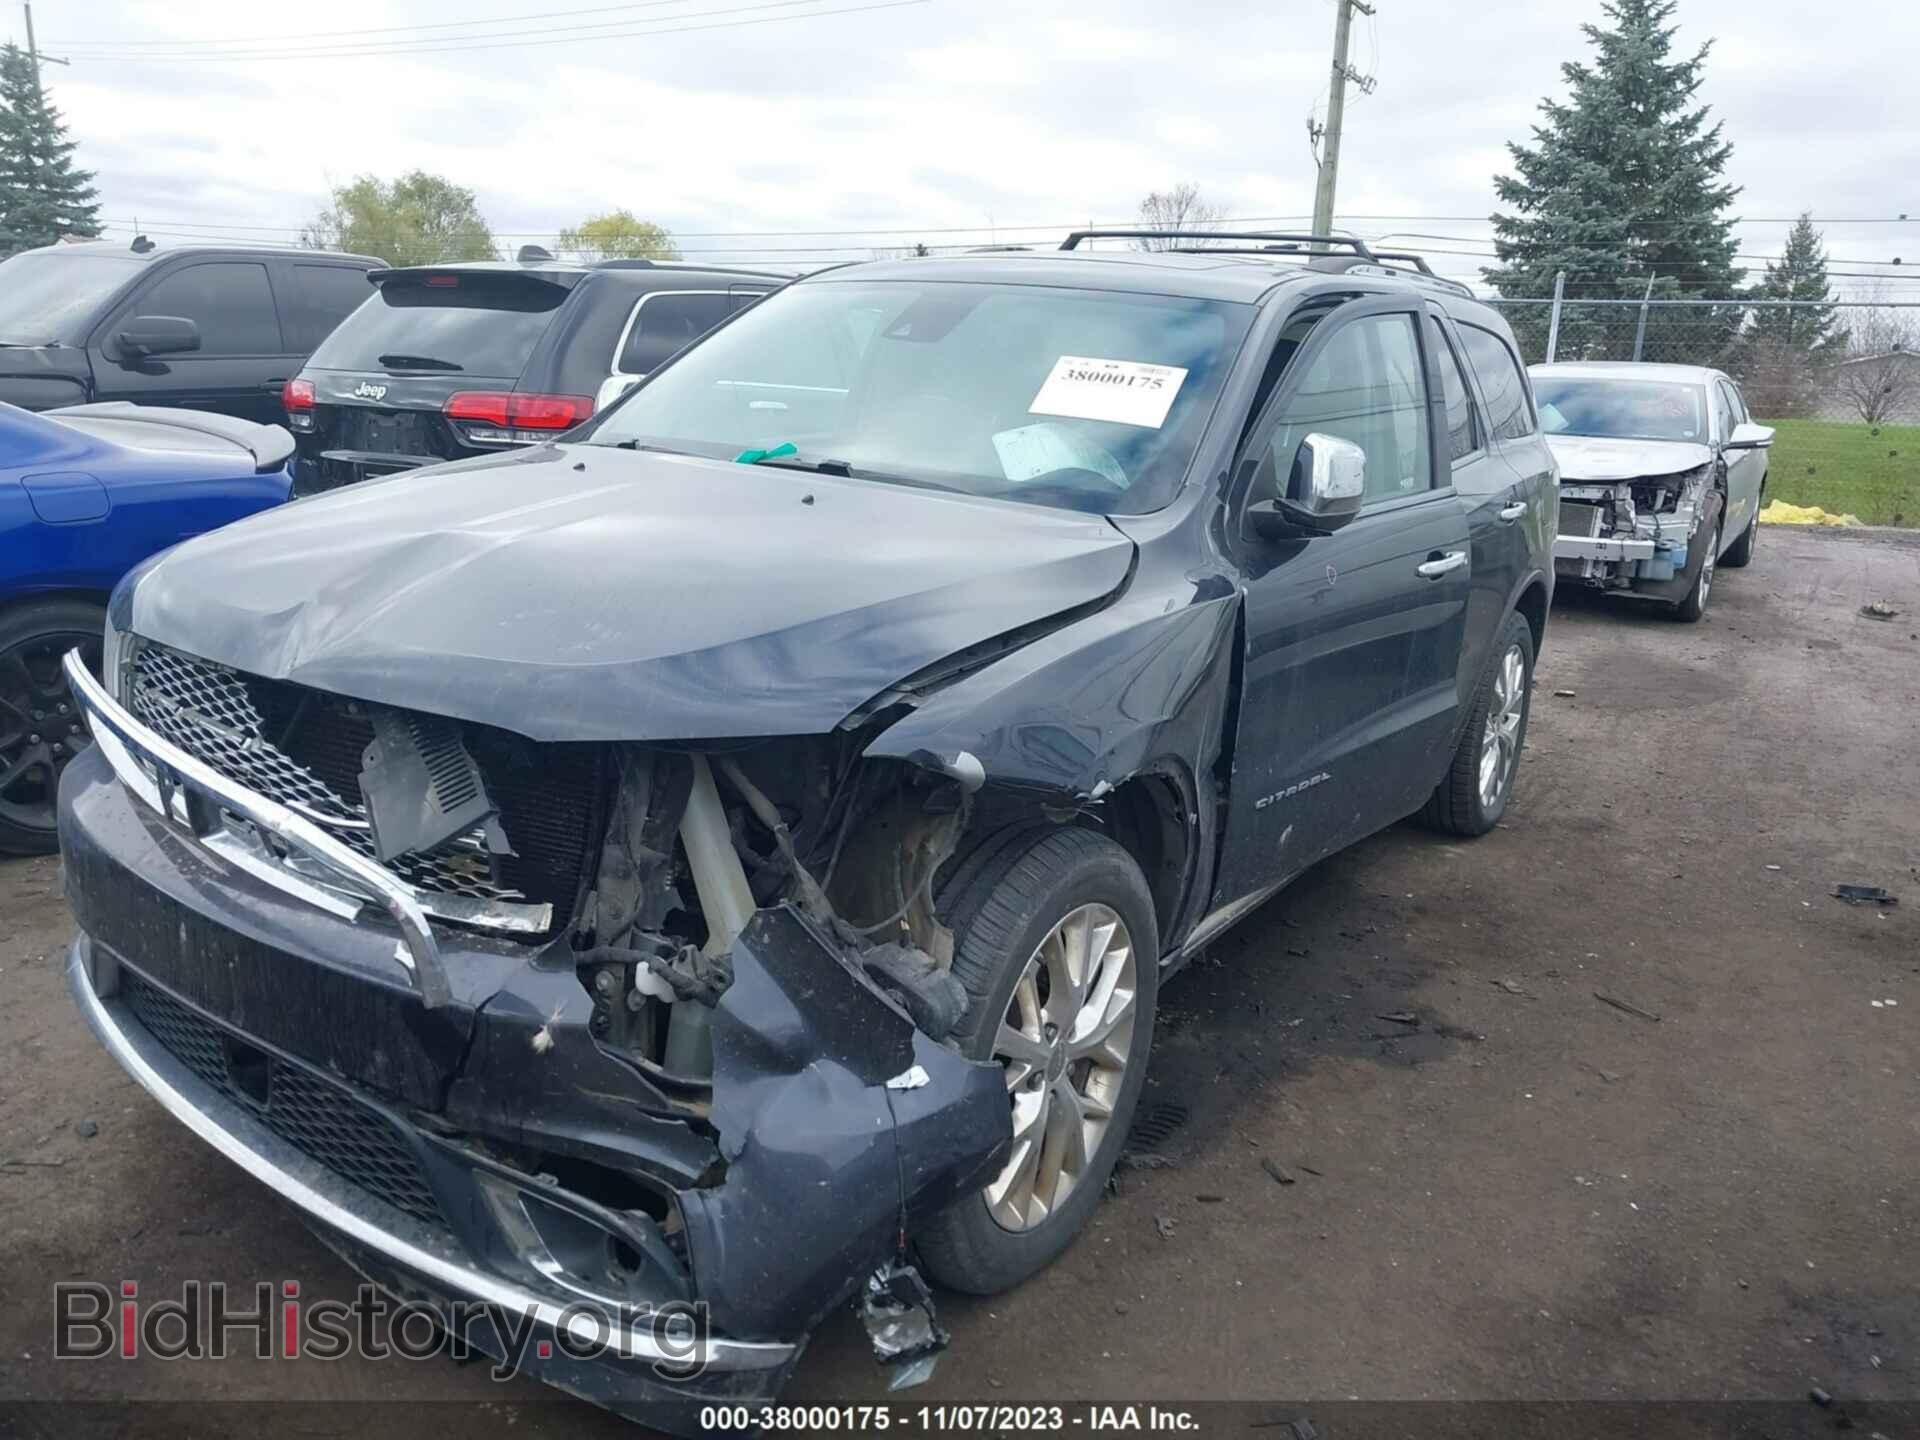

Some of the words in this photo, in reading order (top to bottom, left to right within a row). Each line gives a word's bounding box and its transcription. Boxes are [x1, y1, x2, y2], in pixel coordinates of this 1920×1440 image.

[1061, 368, 1166, 390] 38000175
[355, 381, 387, 400] Jeep
[1255, 772, 1331, 810] CITADEL
